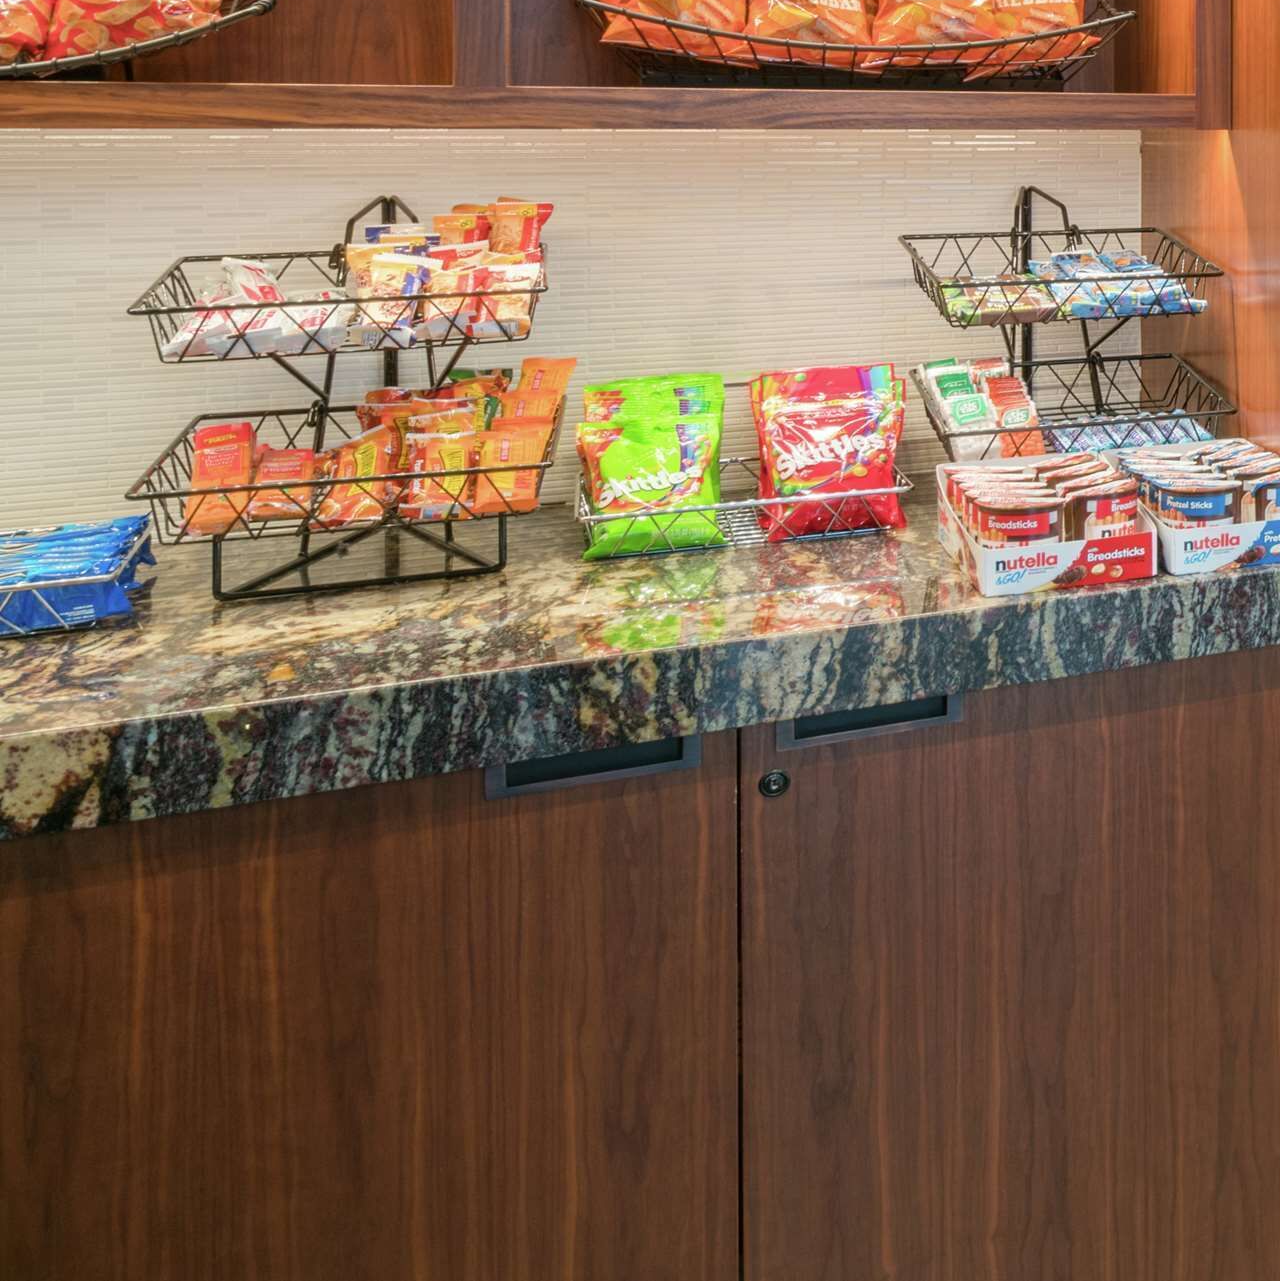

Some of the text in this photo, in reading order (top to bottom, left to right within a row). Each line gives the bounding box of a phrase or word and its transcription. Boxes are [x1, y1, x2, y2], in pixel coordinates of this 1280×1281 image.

[1166, 498, 1214, 510] Pretzel Sticks
[987, 516, 1039, 530] Breadsticks
[1183, 532, 1241, 552] nutella
[994, 551, 1059, 572] nutella
[1087, 545, 1147, 564] Breadsticks
[994, 570, 1027, 586] &GO!
